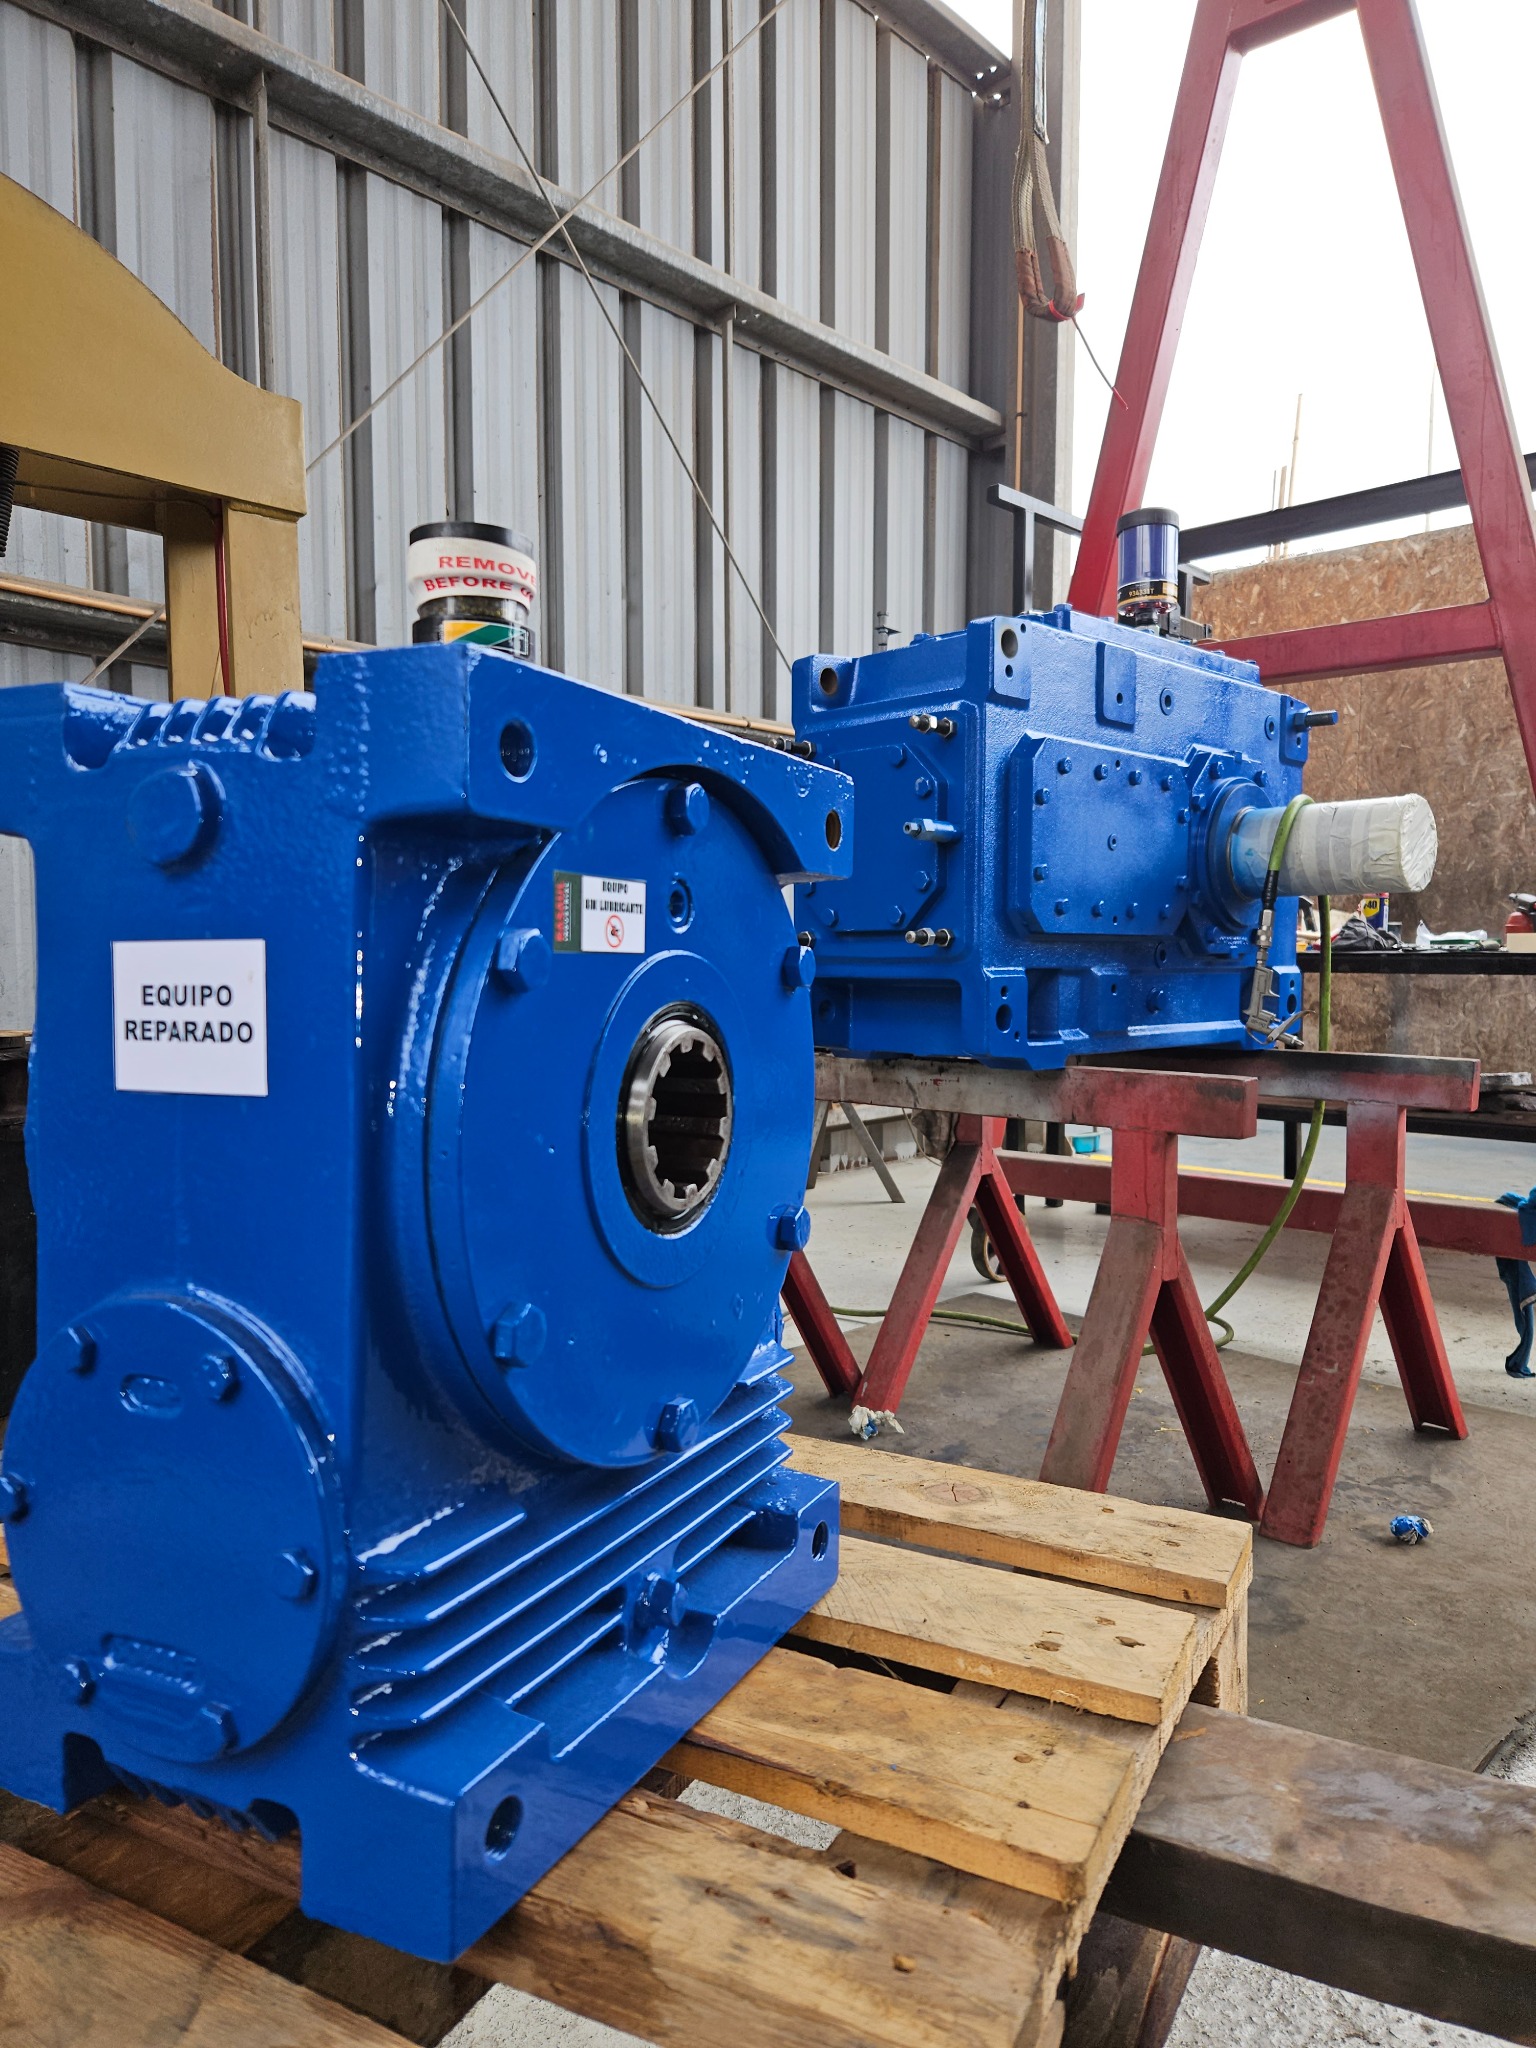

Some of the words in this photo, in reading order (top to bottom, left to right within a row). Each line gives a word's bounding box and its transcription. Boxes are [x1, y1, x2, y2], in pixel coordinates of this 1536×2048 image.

[423, 576, 513, 592] BEFORE
[602, 881, 629, 894] EQUIPO
[600, 900, 643, 914] LUBRICANTE
[142, 985, 232, 1006] EQUIPO
[124, 1020, 253, 1042] REPARADO
